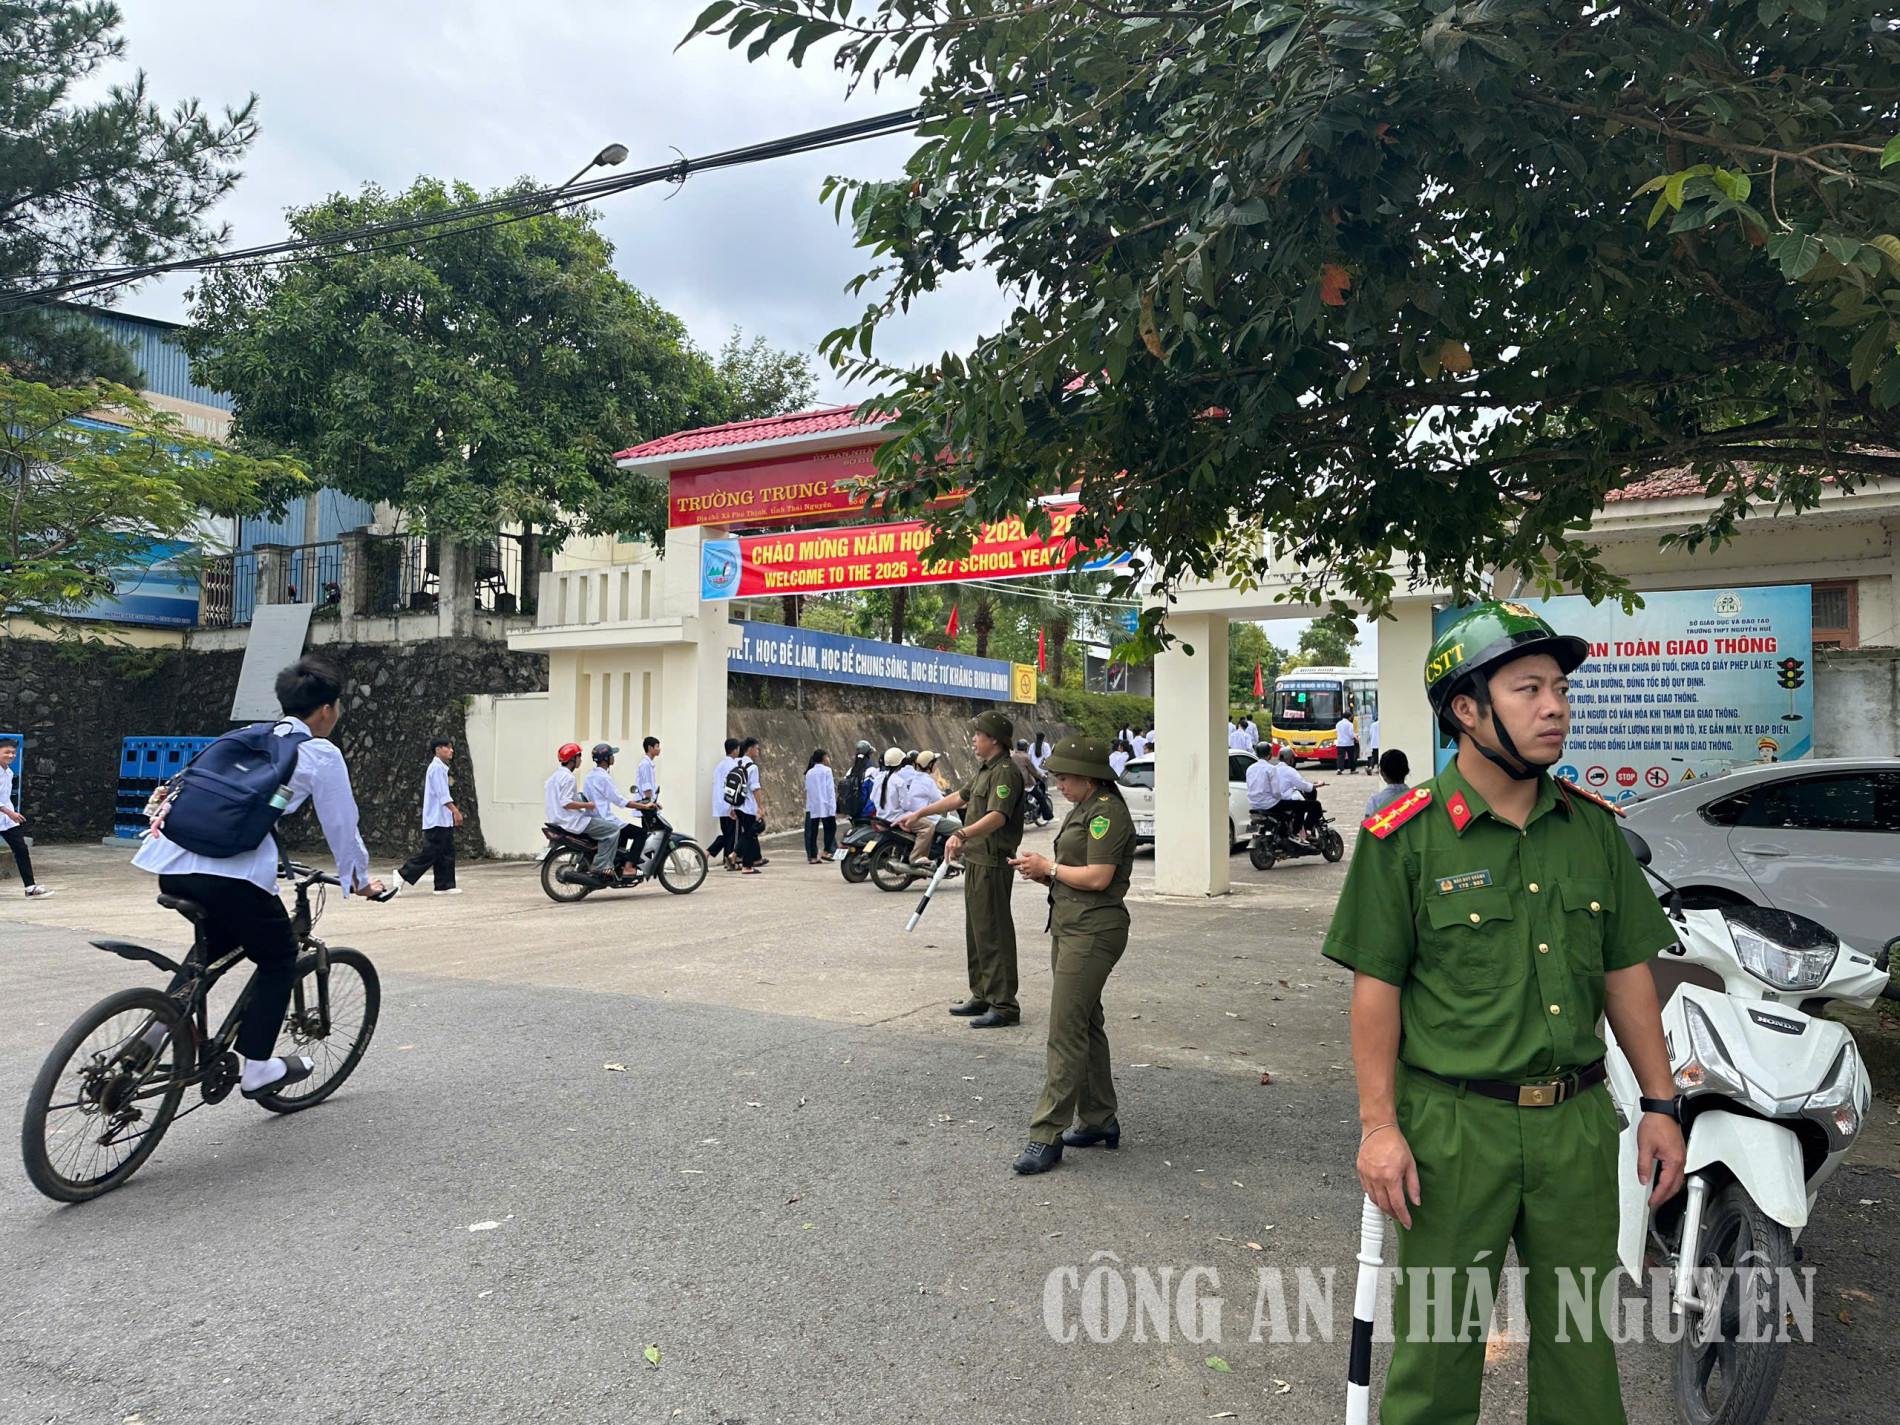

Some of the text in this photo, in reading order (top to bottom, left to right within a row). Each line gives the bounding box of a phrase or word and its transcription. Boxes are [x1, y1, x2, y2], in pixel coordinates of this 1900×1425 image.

[677, 487, 755, 512] TRƯỜNG
[760, 481, 828, 502] TRUNG
[752, 541, 794, 564] CHÀO
[799, 535, 848, 560] MỪNG
[854, 530, 894, 556] NĂM
[764, 566, 825, 588] WELCOME
[828, 566, 844, 582] TO
[848, 564, 871, 580] THE
[875, 560, 908, 578] 2026
[959, 552, 1016, 572] SCHOOL
[1588, 634, 1777, 657] AN TOÀN GIAO THÔNG
[756, 639, 777, 668] HỌC
[780, 634, 794, 666] ĐỂ
[795, 642, 819, 672] LÀM,
[821, 648, 840, 674] HỌC
[842, 644, 854, 672] ĐỂ
[856, 653, 884, 677] CHUNG
[928, 656, 938, 684] ĐỂ
[1426, 642, 1464, 682] CSTT
[1603, 662, 1617, 674] TIỆN
[1620, 663, 1630, 672] KHI
[1632, 662, 1649, 672] CHƯA
[1651, 660, 1660, 672] ĐỦ
[1680, 662, 1699, 671] CHƯA
[1701, 659, 1710, 670] CÓ
[1712, 658, 1728, 670] GIẤY
[1730, 659, 1748, 670] PHÉP
[1764, 660, 1774, 669] XE.
[1586, 677, 1599, 688] LÀN
[1647, 675, 1659, 688] TỐC
[1660, 676, 1670, 689] ĐỘ
[1672, 678, 1686, 687] QUY
[1686, 678, 1706, 689] ĐỊNH.
[1598, 694, 1609, 704] BIA
[1610, 694, 1622, 704] KHI
[1624, 694, 1642, 703] THAM
[1644, 694, 1655, 703] GIA
[1656, 694, 1672, 703] GIAO
[1674, 691, 1698, 702] THÔNG.
[1620, 708, 1632, 719] VĂN
[1650, 710, 1660, 718] KHI
[1662, 709, 1682, 718] THAM
[1684, 709, 1696, 718] GIA
[1697, 709, 1714, 718] GIAO
[1715, 706, 1740, 718] THÔNG.
[1572, 725, 1584, 736] ĐẠT
[1610, 722, 1626, 734] CHẤT
[1652, 725, 1662, 734] KHI
[1664, 725, 1672, 734] ĐI
[1698, 725, 1707, 734] XE
[1744, 725, 1753, 734] XE
[1755, 724, 1770, 736] ĐẠP
[1663, 741, 1672, 750] TAI
[1674, 741, 1689, 752] NẠN
[1690, 741, 1706, 750] GIAO
[1708, 738, 1734, 750] THÔNG.
[1618, 773, 1636, 781] STOP
[1756, 1015, 1800, 1032] HONDA
